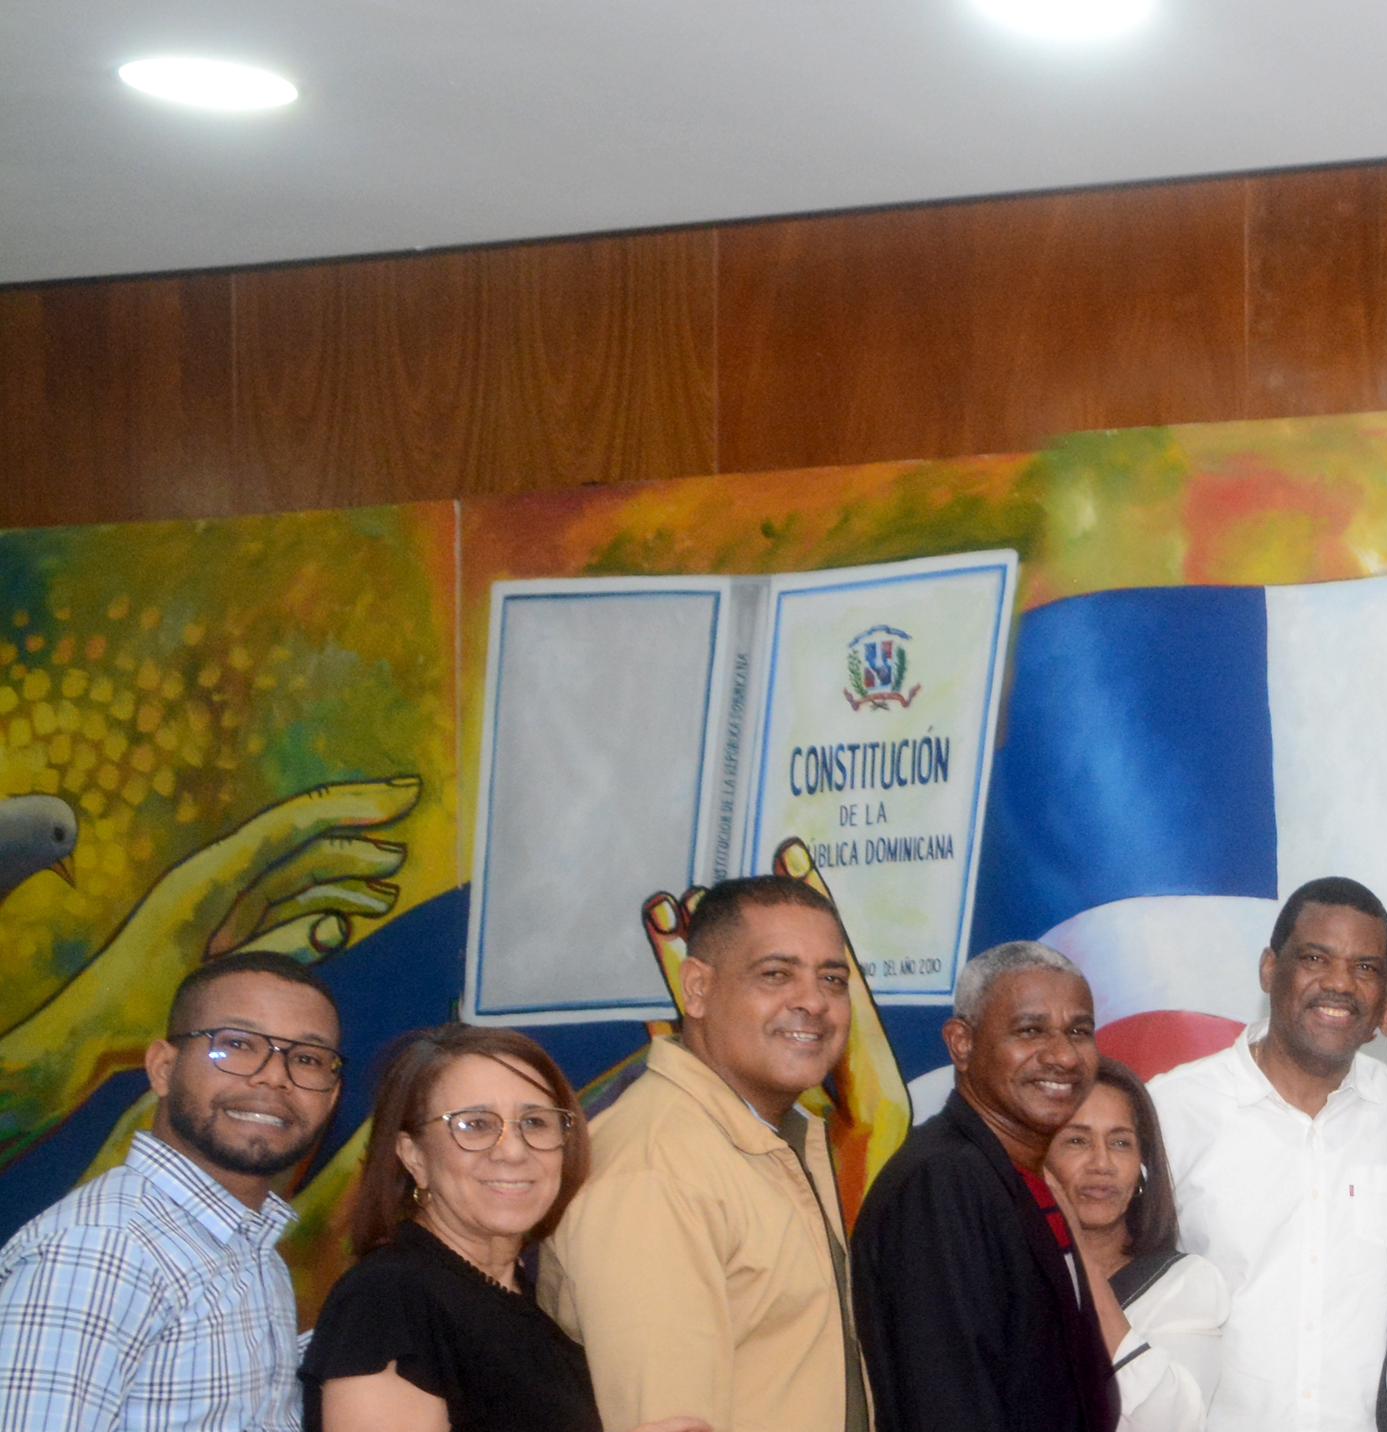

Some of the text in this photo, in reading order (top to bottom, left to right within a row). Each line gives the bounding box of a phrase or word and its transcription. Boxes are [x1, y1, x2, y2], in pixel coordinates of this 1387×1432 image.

[790, 725, 950, 797] CONSTITUCIÓN
[839, 801, 888, 827] DE LA
[865, 833, 955, 865] DOMINICANA
